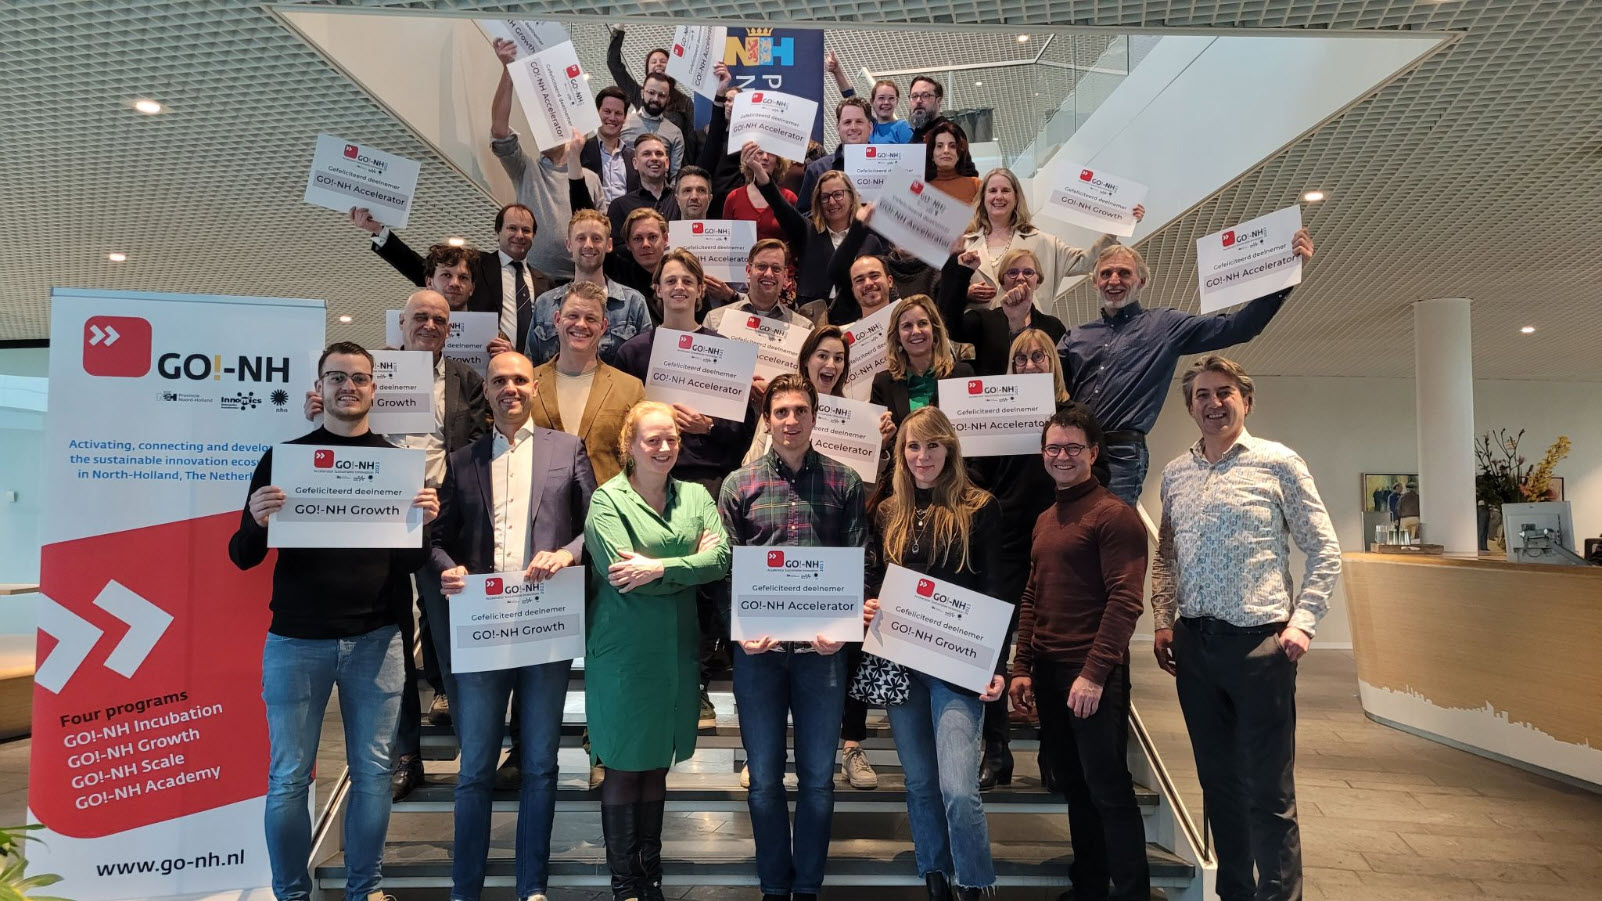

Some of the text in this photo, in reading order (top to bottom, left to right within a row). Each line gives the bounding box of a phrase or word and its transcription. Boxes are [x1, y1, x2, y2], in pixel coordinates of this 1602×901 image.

[515, 24, 535, 53] Growth
[725, 36, 794, 66] NH
[531, 62, 564, 138] GO!-NH Accelerator
[733, 123, 804, 142] GO!-NH Accelerator
[358, 154, 385, 168] GO!-NH
[328, 166, 366, 181] Gefeliciteerd
[317, 175, 405, 206] GO!-NH Accelerator
[1092, 179, 1116, 190] GO!-NH
[1061, 196, 1123, 220] GO!-NH Growth
[1236, 228, 1264, 243] GO!-NH
[1206, 255, 1296, 288] GO!-NH Accelerator
[692, 344, 720, 355] GO!-NH
[158, 353, 289, 383] GO!-NH
[374, 362, 393, 370] !-NH
[663, 361, 701, 372] Gefeliciteerd
[756, 355, 799, 370] ccelerato
[653, 372, 743, 396] GO!-NH Accelerator
[984, 386, 1015, 394] GO!-NH
[377, 398, 417, 407] Growth
[819, 405, 848, 417] GO!-NH
[957, 408, 1000, 416] Gefeliciteerd
[990, 420, 1045, 430] Accelerato
[830, 427, 867, 440] deelnemer
[69, 440, 136, 451] Activating,
[138, 442, 204, 453] connecting
[206, 443, 229, 452] and
[815, 439, 873, 457] Accelerator
[70, 455, 91, 464] the
[93, 456, 163, 466] sustainable
[165, 456, 229, 466] innovation
[335, 460, 375, 470] GO!-NH
[78, 470, 253, 481] in North-Holland, The Netherl
[295, 487, 403, 496] Gefeliciteerd deelnemer
[295, 505, 400, 516] GO!-NH Growth
[785, 560, 819, 569] GO!-NH
[505, 583, 540, 595] GO!-NH
[741, 600, 855, 611] GO!-NH Accelerator
[933, 592, 967, 610] GO!-NH
[471, 606, 566, 622] Gefeliciteerd deelnemer
[895, 605, 984, 641] Gefeliciteerd deelnemer
[472, 621, 565, 641] GO!-NH Growth
[891, 621, 978, 659] GO!-NH Growth
[60, 691, 189, 728] Four programs
[63, 703, 224, 749] GO!-NH Incubation
[68, 728, 201, 769] GO!-NH Growth
[71, 753, 185, 790] GO!-NH Scale
[75, 765, 222, 810] GO!-NH Academy
[96, 849, 246, 877] www.go-nh.nl
